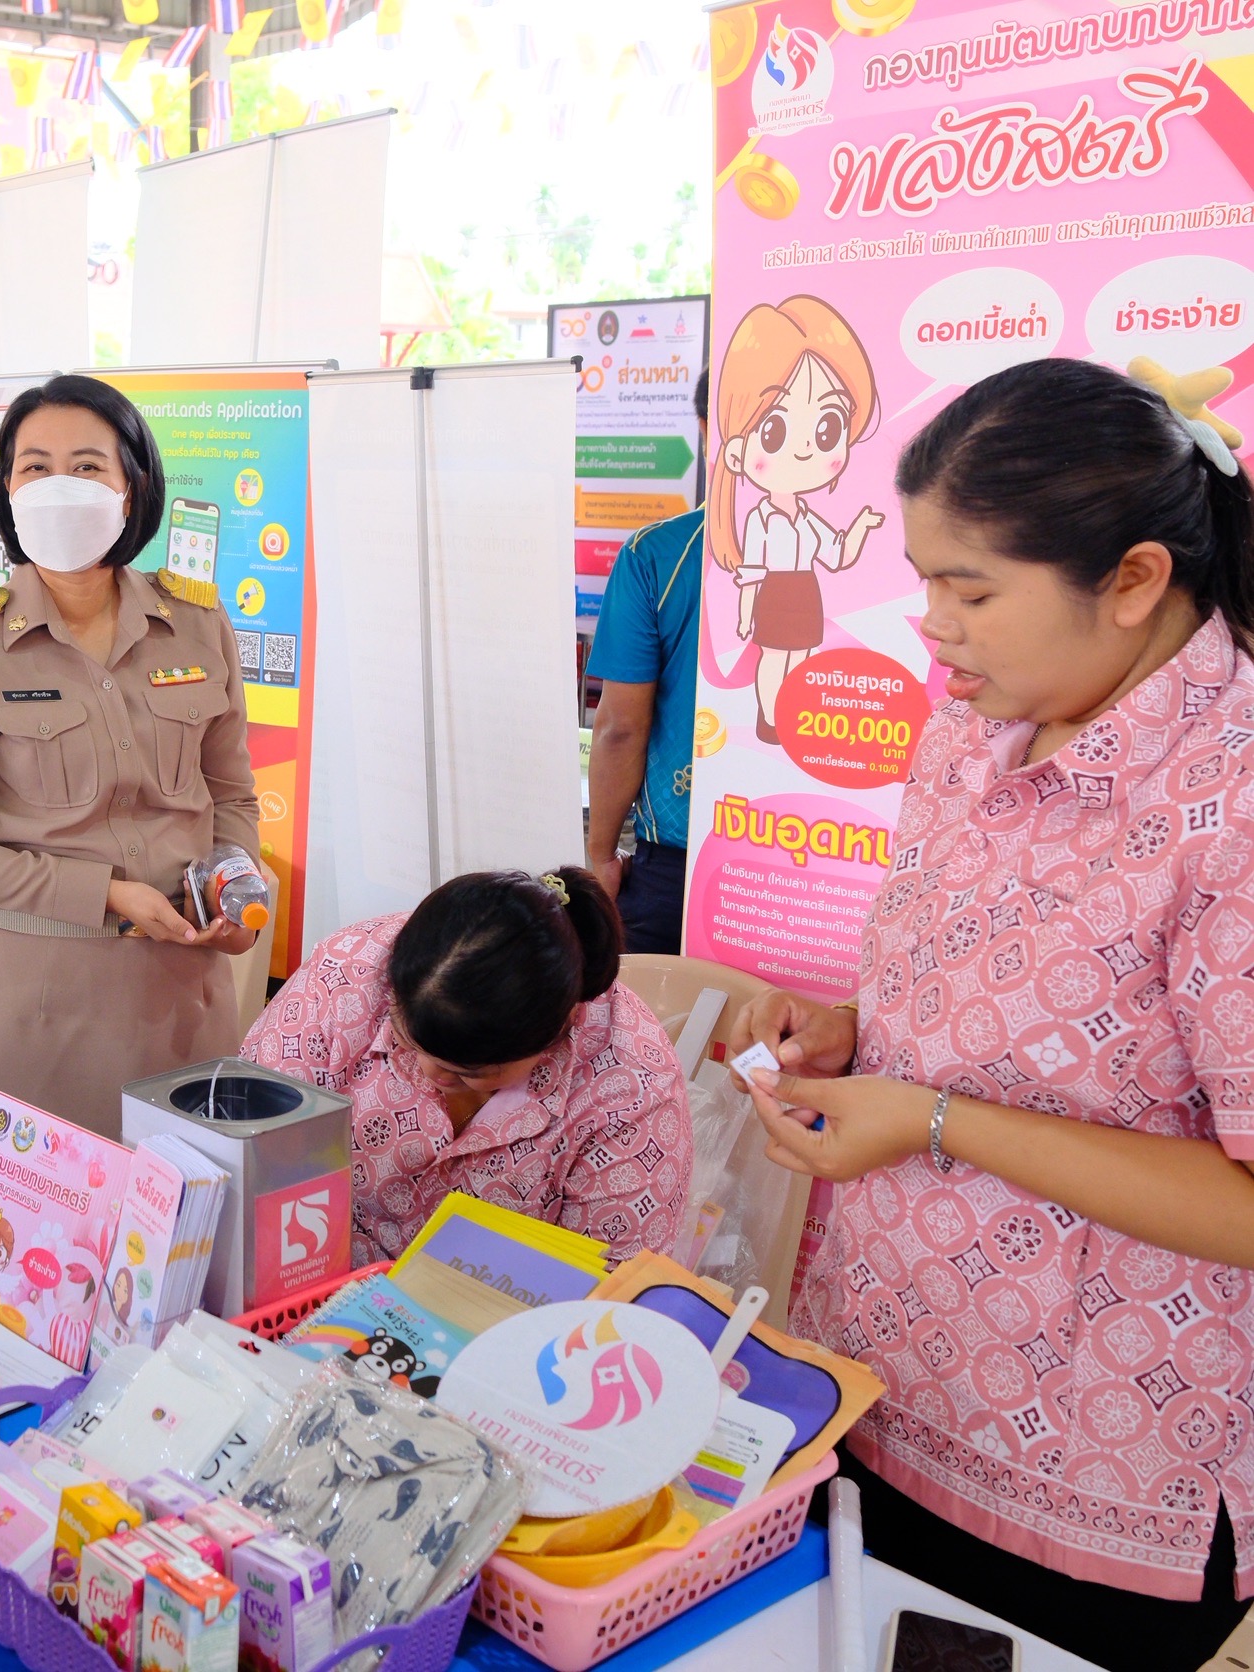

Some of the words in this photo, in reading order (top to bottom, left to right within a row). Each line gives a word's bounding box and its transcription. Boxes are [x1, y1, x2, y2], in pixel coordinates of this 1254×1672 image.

[863, 0, 1254, 90] กองทุนพัฒนาบทบาท
[757, 99, 824, 125] บทบาทสตรี
[827, 55, 1206, 217] พลังสตรี
[764, 242, 833, 268] เสริมโอกาส
[839, 231, 924, 261] สร้างรายได้
[932, 225, 1050, 253] พัฒนาศักยภาพ
[916, 302, 1048, 345] ดอกเบี้ยต่ำ
[1114, 296, 1242, 333] ชำระง่าย
[617, 355, 689, 386] ส่วนหน้า
[216, 399, 302, 423] Application
[171, 429, 187, 439] One
[189, 429, 205, 441] App
[223, 449, 239, 461] App
[805, 670, 904, 697] วงเงินสูงสุด
[821, 692, 885, 712] โครงการละ
[796, 710, 911, 748] 200,000
[802, 754, 866, 771] ดอกเบี้ยร้อยละ
[869, 762, 899, 775] 0.10/ปี
[883, 747, 907, 760] บาท
[721, 863, 765, 883] เป็นเงินทุน
[768, 871, 809, 892] (ให้เปล่า)
[719, 896, 784, 921] ในการเฝ้าระวัง
[757, 961, 854, 989] สตรีและองค์กรสตรี
[28, 1257, 57, 1280] ชำระง่าย
[279, 1254, 330, 1279] กองทุนพัฒนา
[284, 1264, 326, 1289] บทบาทสตรี
[383, 1308, 424, 1346] WISHES
[503, 1408, 591, 1453] กองทุนพัฒนา
[87, 1575, 130, 1620] fresh
[242, 1588, 284, 1628] fresh
[152, 1614, 186, 1657] fresh
